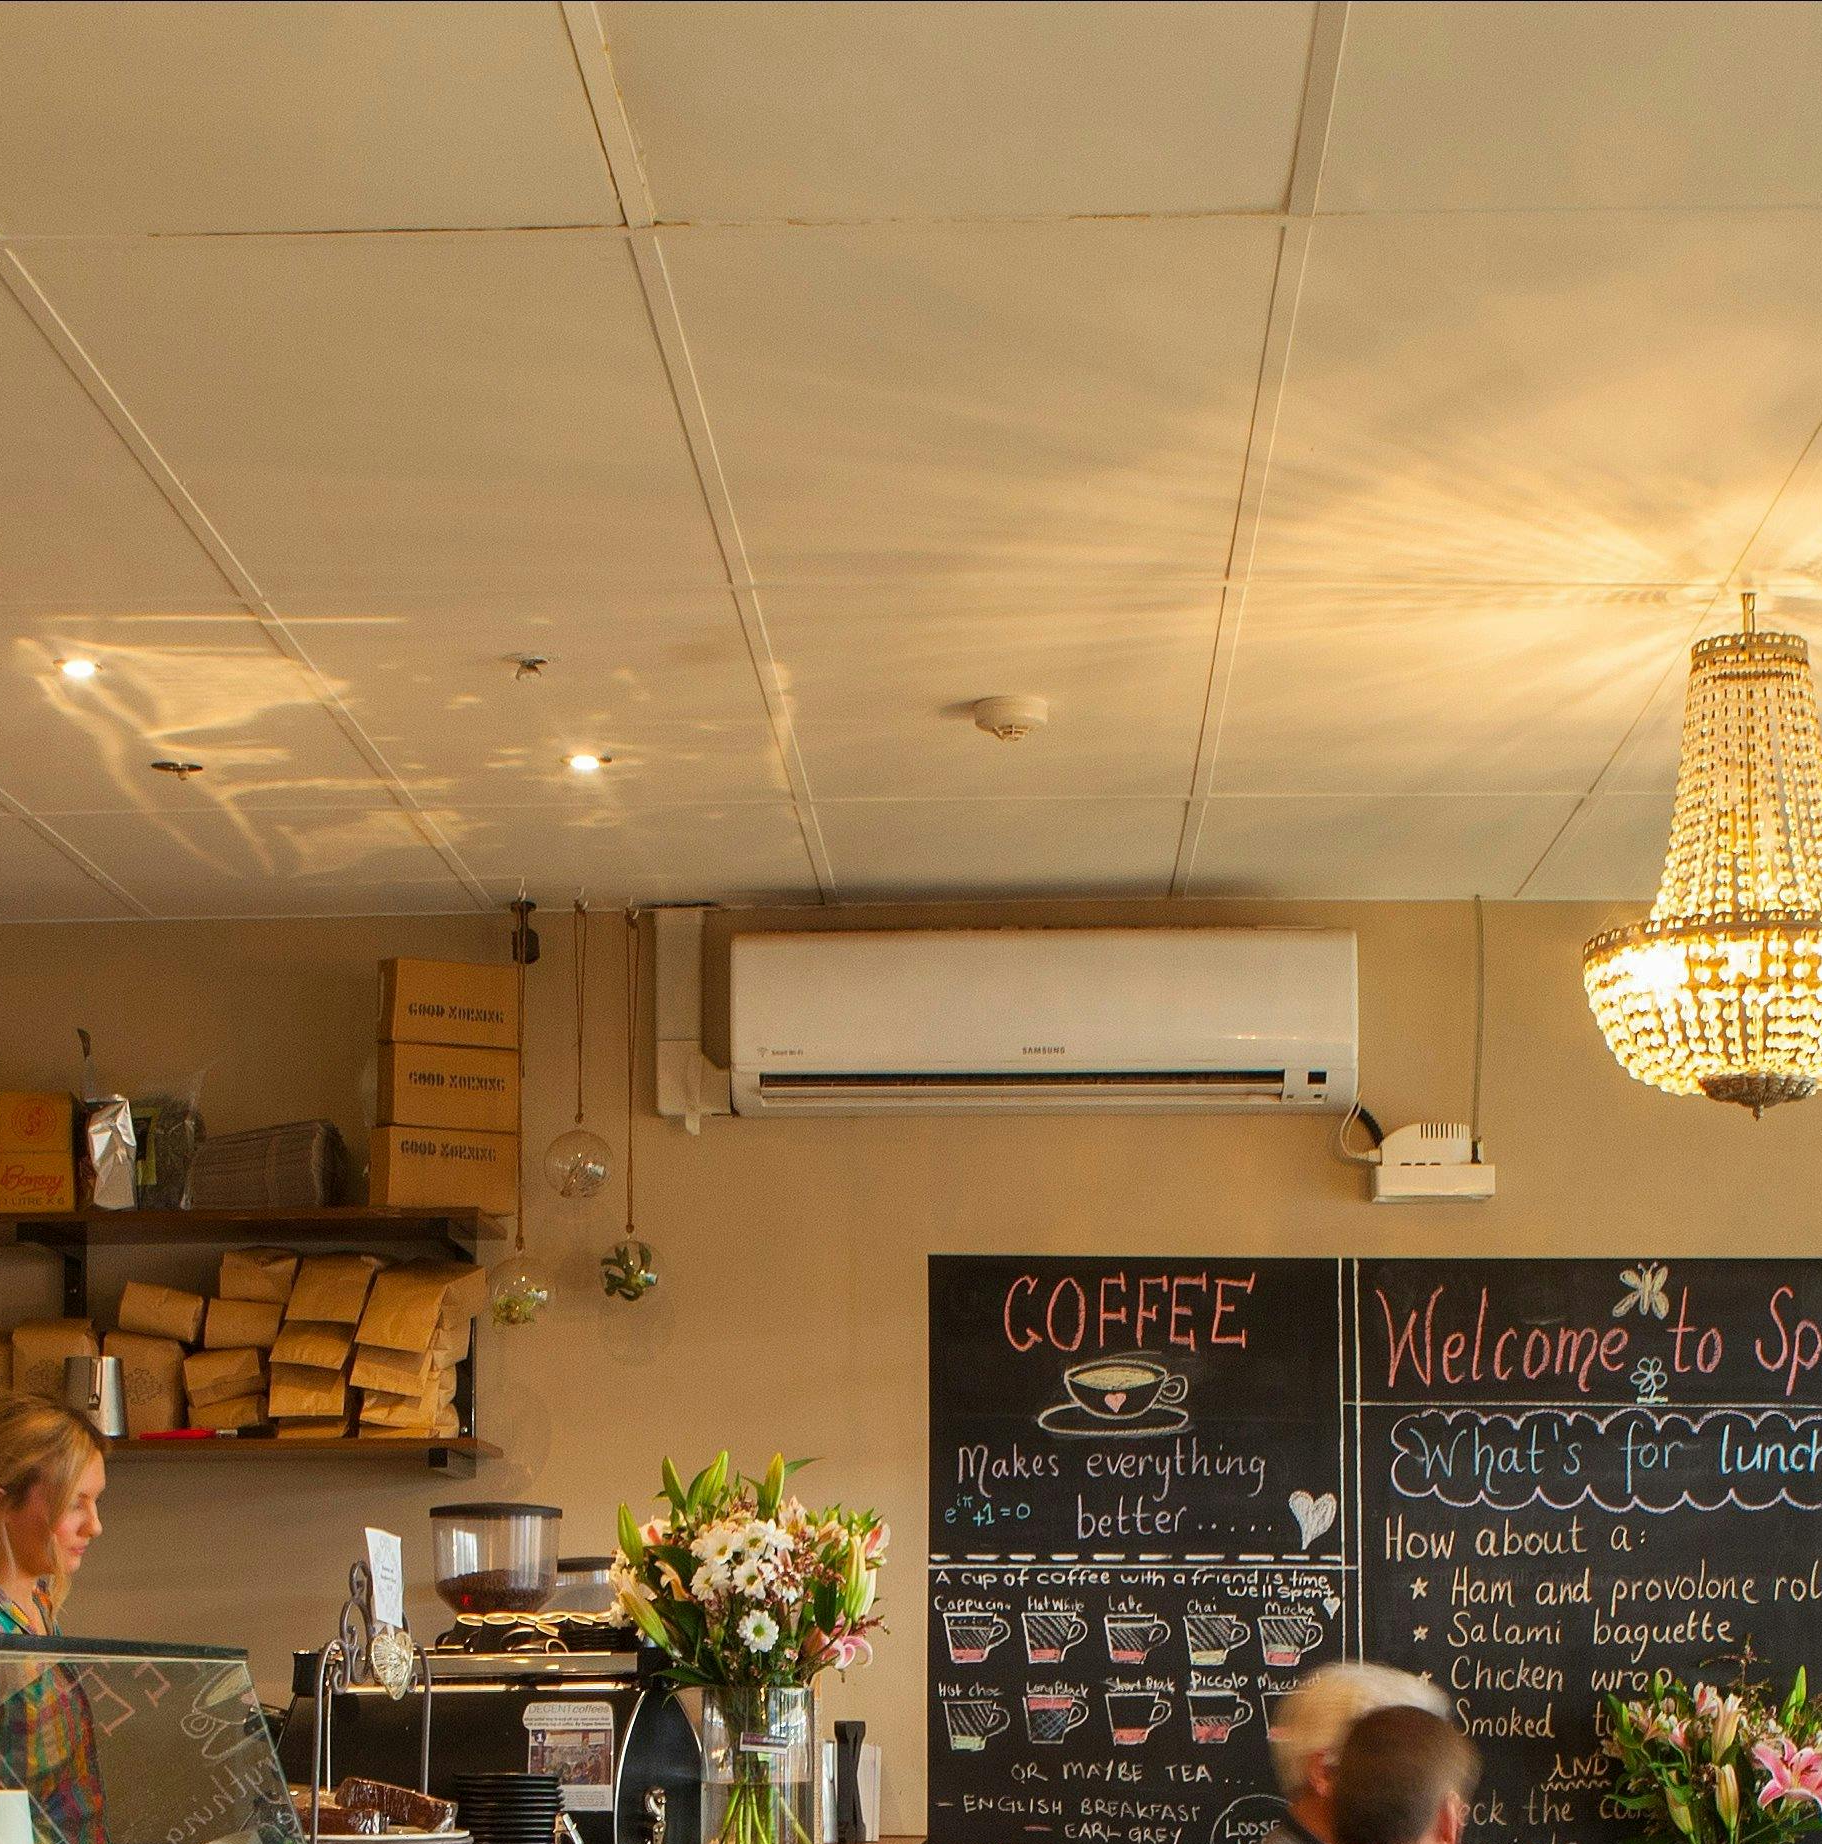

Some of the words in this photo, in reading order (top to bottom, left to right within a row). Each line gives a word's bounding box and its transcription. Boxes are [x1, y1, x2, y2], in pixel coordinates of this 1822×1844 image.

[408, 1002, 446, 1019] GOOD
[447, 1003, 506, 1026] MORNING
[1021, 1046, 1066, 1055] SAMSUNG
[408, 1070, 446, 1088] GOOD
[448, 1073, 506, 1094] MORNING
[399, 1139, 437, 1157] GOOD
[439, 1141, 498, 1164] MORNING
[1003, 1271, 1256, 1352] COFFEE
[1376, 1285, 1632, 1392] Welcome
[1667, 1285, 1723, 1375] to
[956, 1444, 1060, 1498] Makes
[1086, 1436, 1267, 1502] everything
[1409, 1422, 1582, 1494] What's
[1619, 1421, 1687, 1493] for
[1384, 1512, 1456, 1562] How
[1474, 1515, 1588, 1556] about
[936, 1570, 952, 1585] A
[961, 1572, 998, 1596] cup
[1005, 1568, 1029, 1588] of
[1037, 1568, 1110, 1589] coffee
[1120, 1569, 1166, 1588] with
[1174, 1573, 1188, 1587] a
[1191, 1569, 1259, 1588] friend
[1265, 1572, 1284, 1586] is
[1226, 1583, 1273, 1599] well
[1278, 1584, 1336, 1604] spent
[1450, 1567, 1515, 1608] Ham
[1535, 1566, 1593, 1607] and
[1610, 1559, 1759, 1617] provolone
[1187, 1598, 1217, 1614] Chai
[1264, 1601, 1316, 1616] Mocha
[1447, 1610, 1562, 1648] Salami
[1593, 1608, 1735, 1663] baguette
[1190, 1671, 1249, 1690] Piccolo
[1450, 1655, 1565, 1693] Chicken
[938, 1682, 964, 1698] Hot
[1458, 1699, 1555, 1740] Smoked
[1010, 1761, 1048, 1781] OR
[1062, 1761, 1143, 1781] MAYBE
[1166, 1764, 1212, 1782] TEA
[1548, 1751, 1609, 1782] AND
[962, 1797, 1064, 1816] ENGLISH
[1080, 1799, 1201, 1822] BREAKFAST
[1523, 1785, 1574, 1827] the
[1064, 1823, 1121, 1839] EARL
